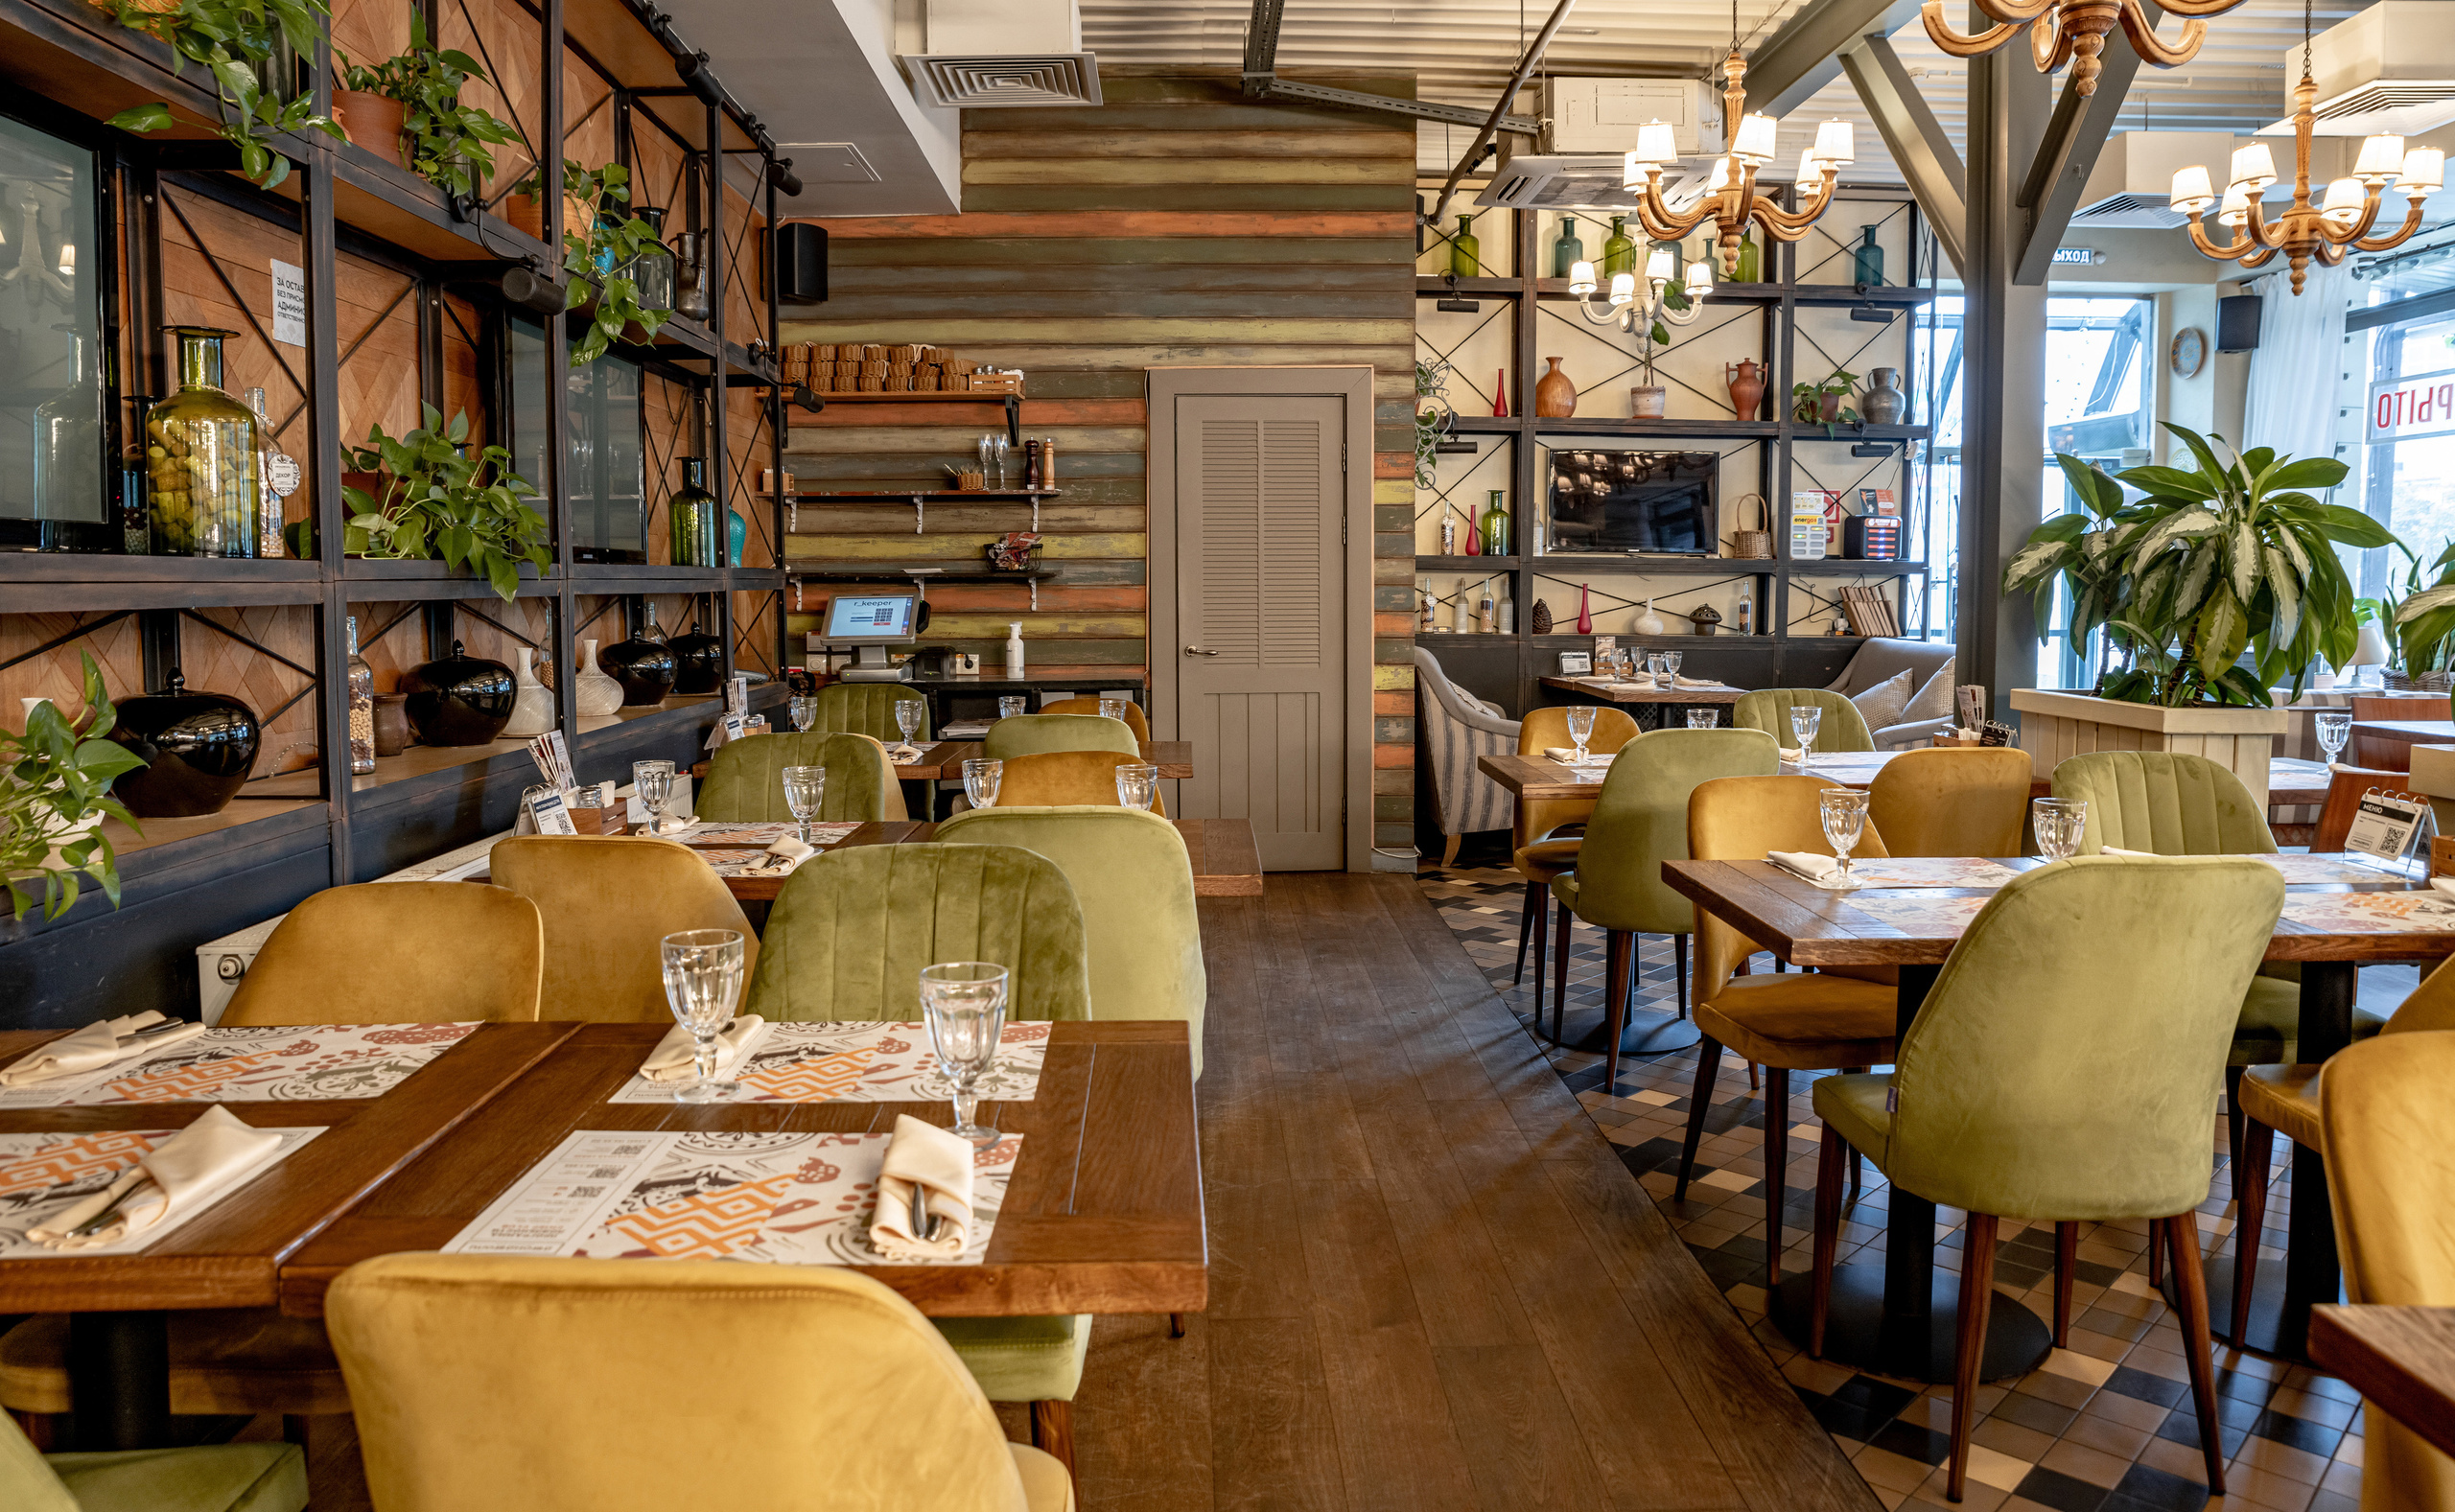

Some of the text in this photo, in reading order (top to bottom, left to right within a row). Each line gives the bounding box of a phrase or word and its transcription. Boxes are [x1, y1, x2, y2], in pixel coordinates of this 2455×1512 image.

[2052, 249, 2090, 264] ЫХОД
[276, 277, 285, 288] ЗА
[277, 290, 286, 298] БЕЗ
[2363, 803, 2383, 814] МЕНЮ
